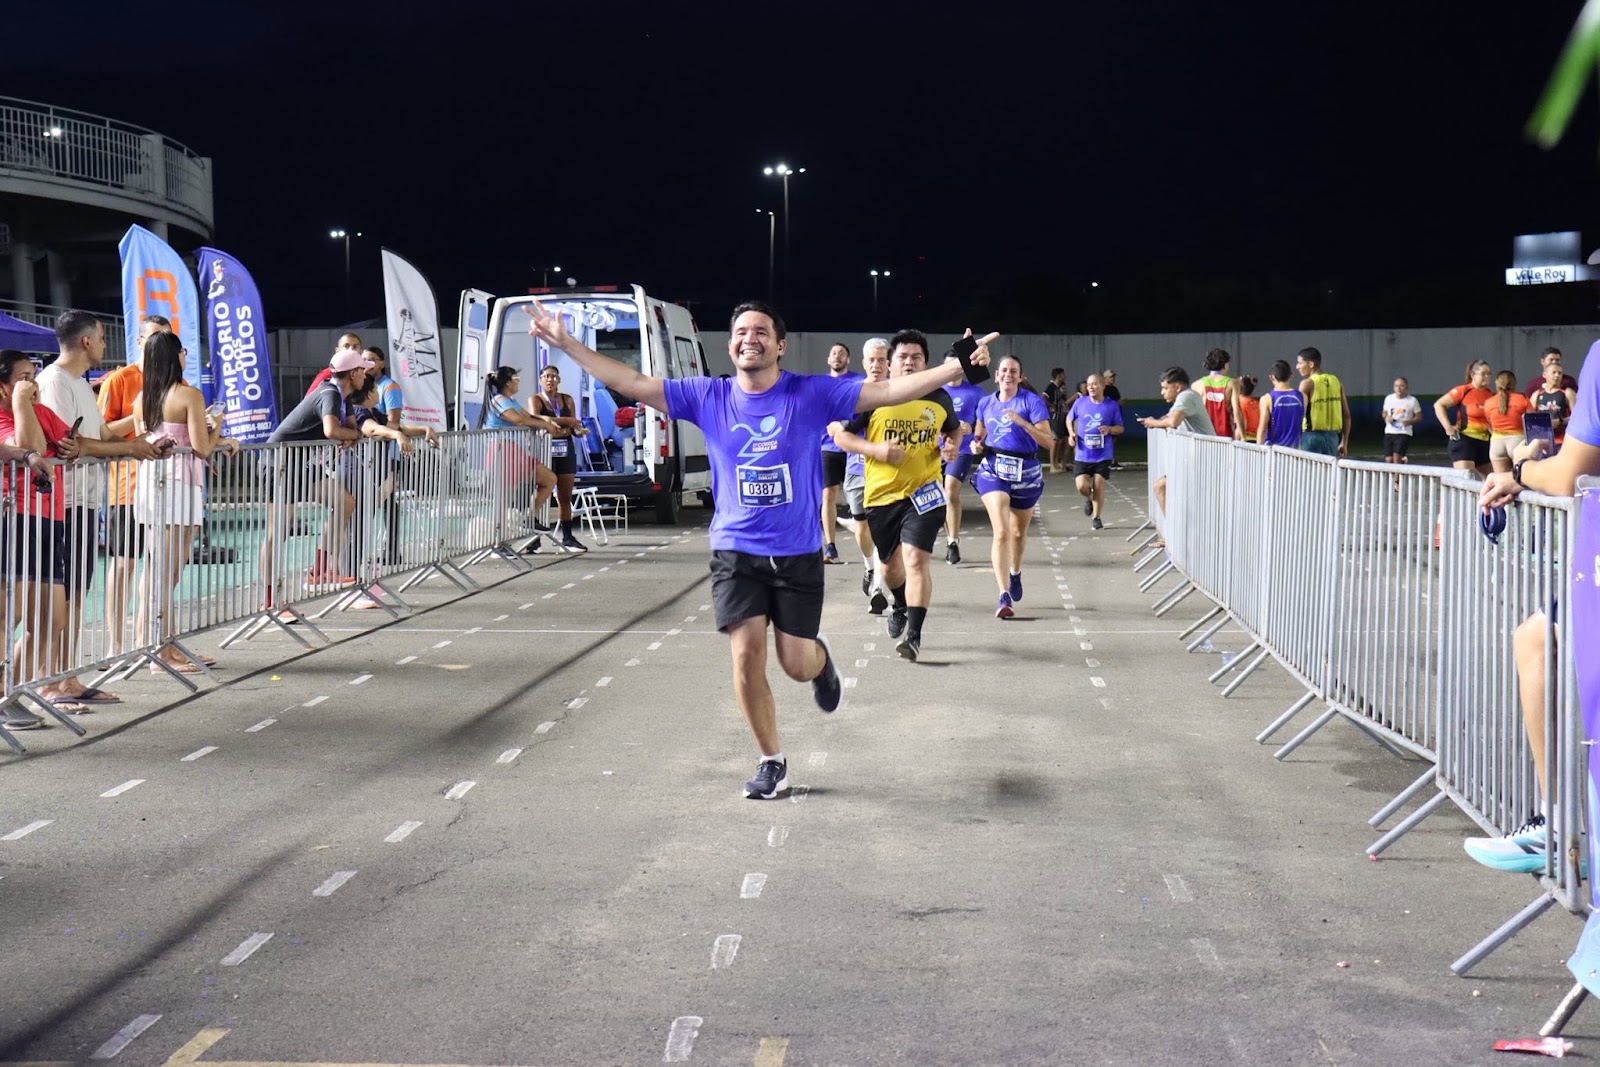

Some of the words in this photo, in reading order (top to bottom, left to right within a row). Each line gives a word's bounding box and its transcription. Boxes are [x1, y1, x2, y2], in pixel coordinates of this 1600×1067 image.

[1544, 269, 1566, 281] Roy
[214, 301, 241, 412] EMPÓRIO
[232, 338, 245, 372] DOS
[236, 305, 262, 401] ÓCULOS
[404, 328, 418, 379] VERSION
[413, 328, 438, 377] MA
[884, 419, 922, 434] CORRE
[749, 483, 776, 495] 0387
